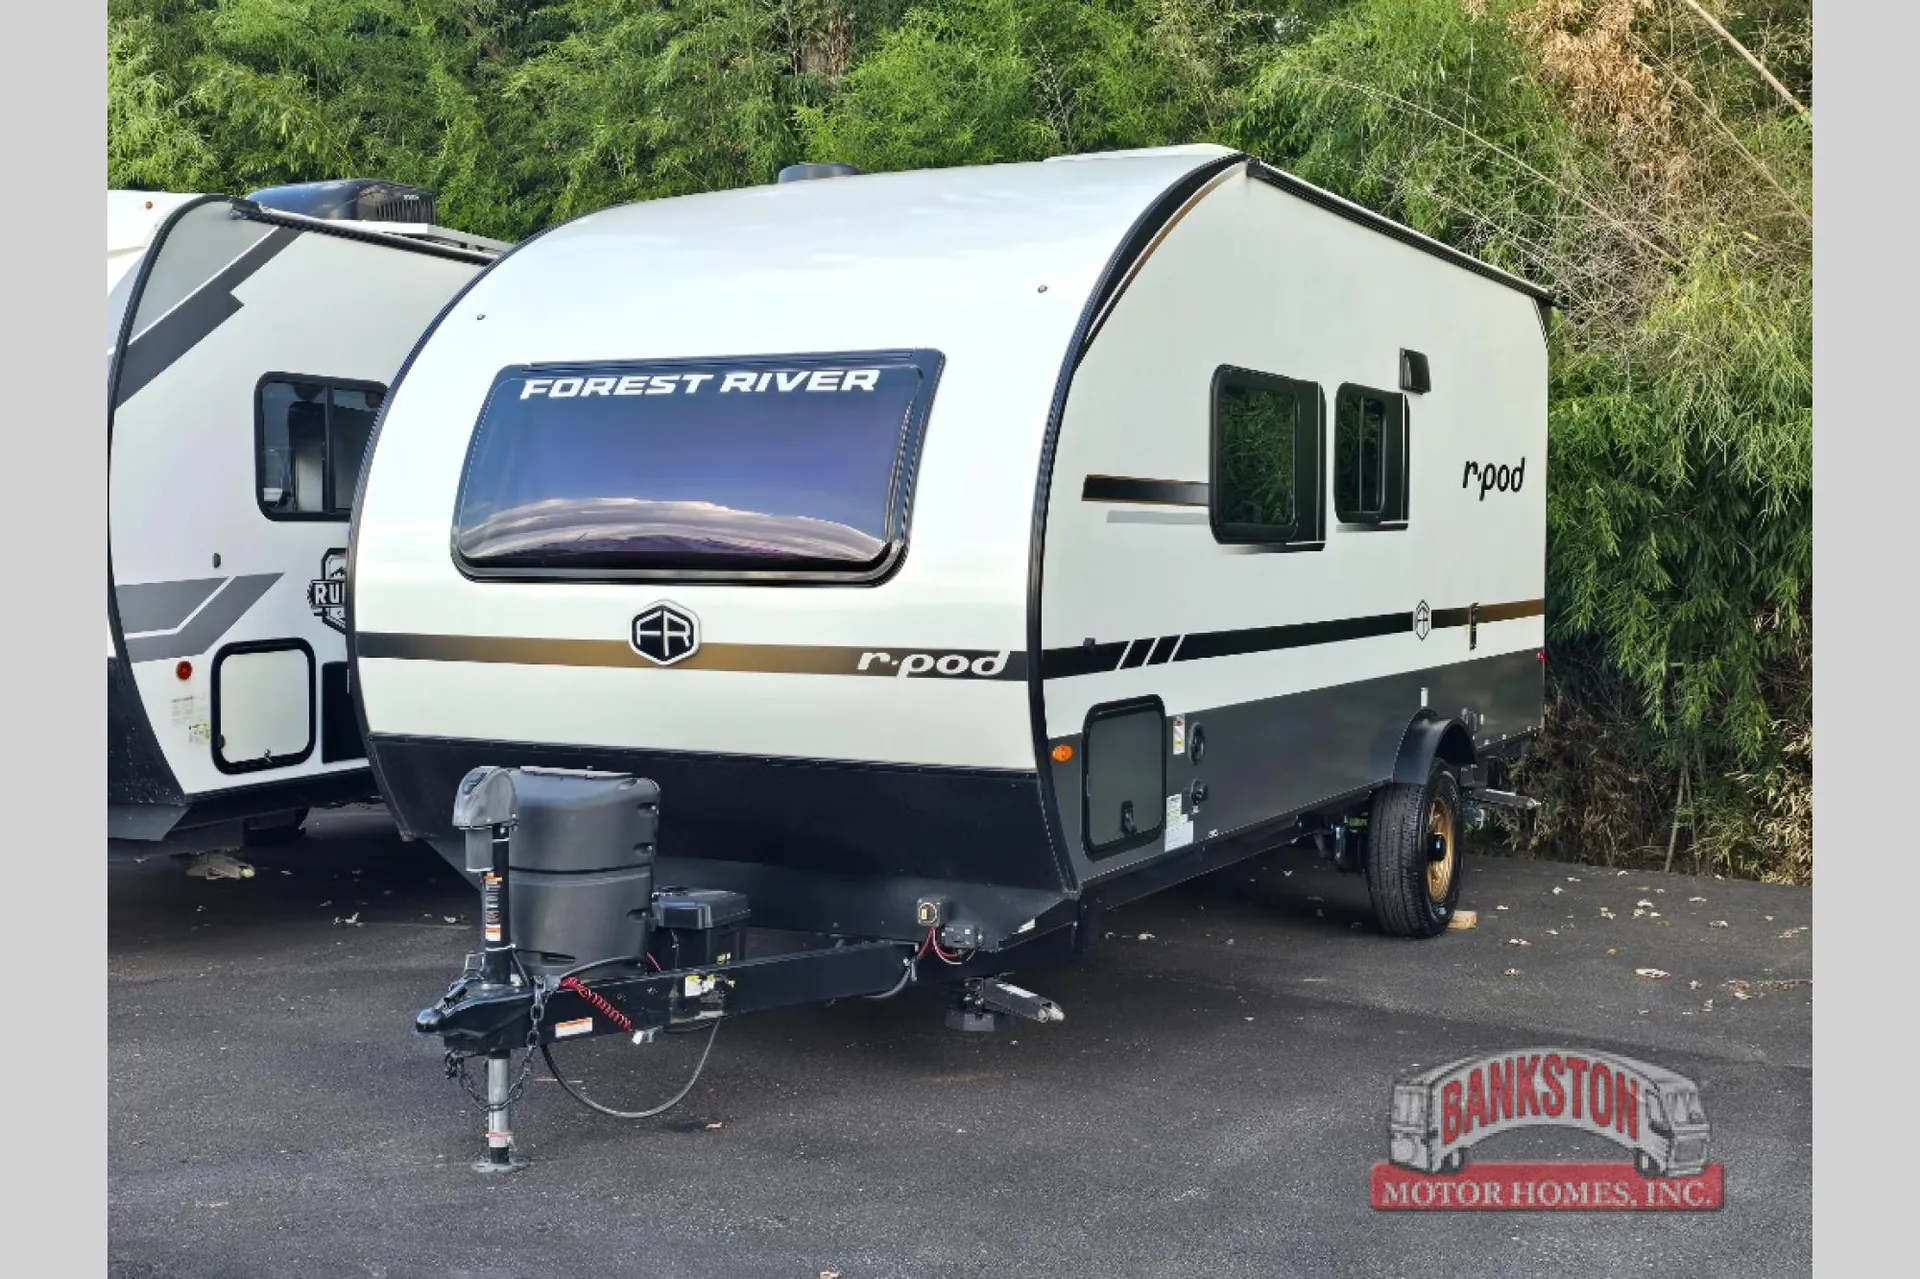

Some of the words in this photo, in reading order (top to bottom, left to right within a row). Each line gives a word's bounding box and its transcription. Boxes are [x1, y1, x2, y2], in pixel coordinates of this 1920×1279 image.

[519, 372, 714, 401] FOREST
[719, 368, 881, 394] RIVER
[314, 583, 346, 604] RU
